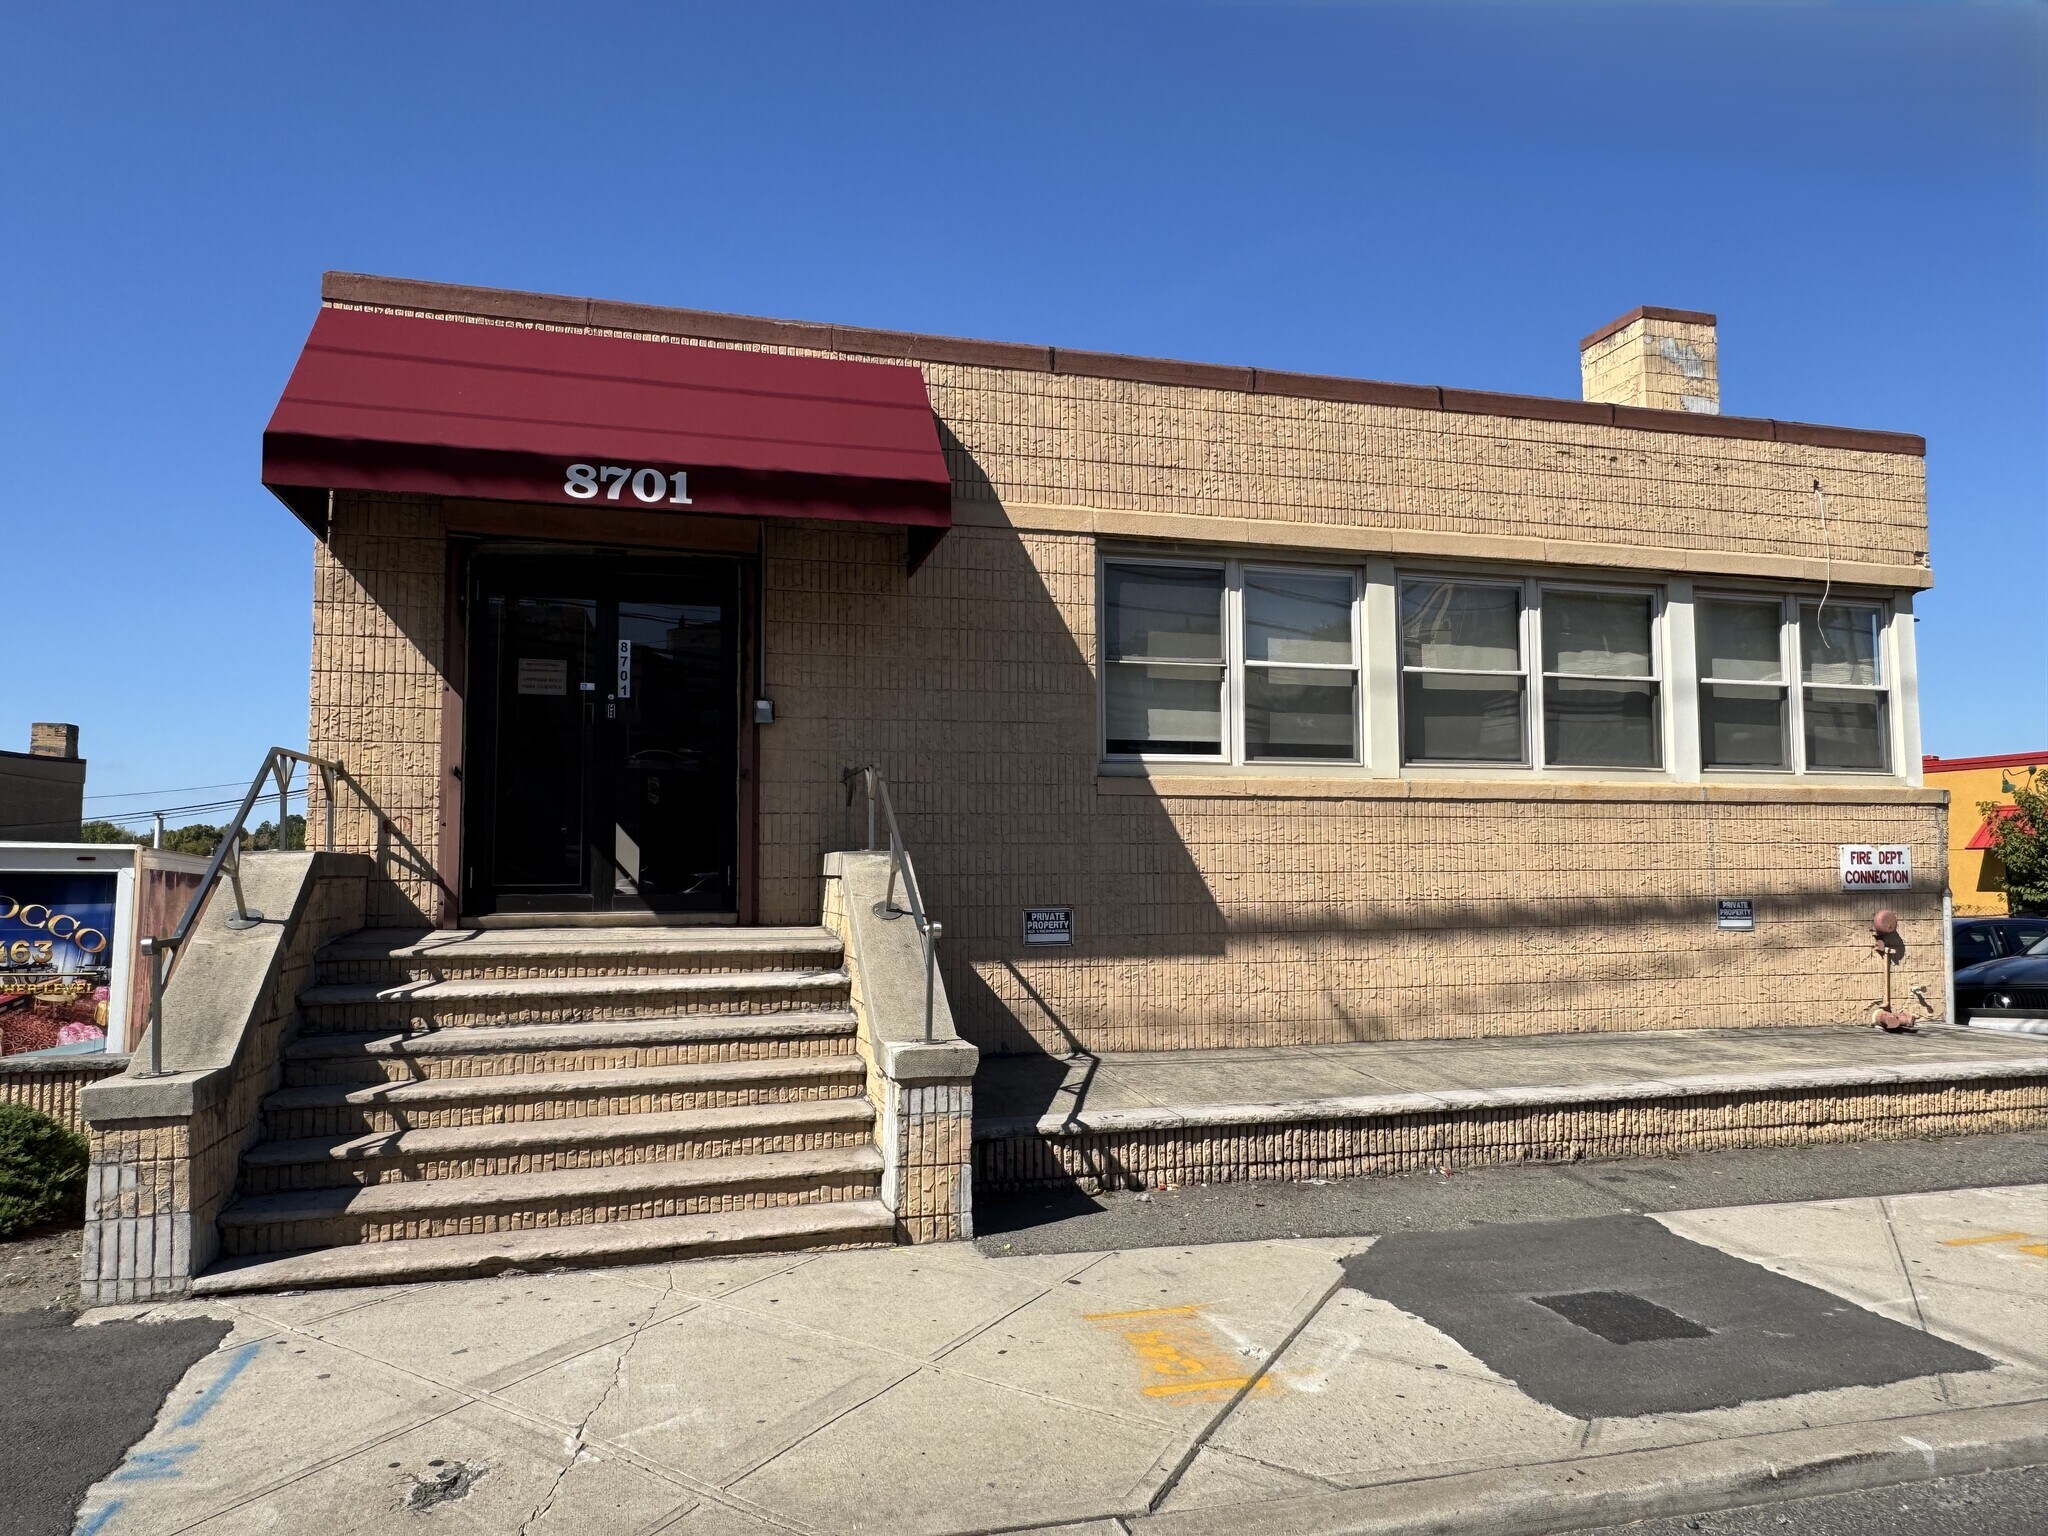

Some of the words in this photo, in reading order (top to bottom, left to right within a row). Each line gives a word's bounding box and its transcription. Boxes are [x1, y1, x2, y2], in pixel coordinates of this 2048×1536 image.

[563, 463, 693, 504] 8701
[620, 641, 629, 697] 8701
[1850, 850, 1872, 865] FIRE
[1878, 850, 1905, 865] DEPT.
[1845, 869, 1909, 884] CONNECTION
[1031, 912, 1066, 921] PRIVATE
[1027, 920, 1069, 929] PROPERTY
